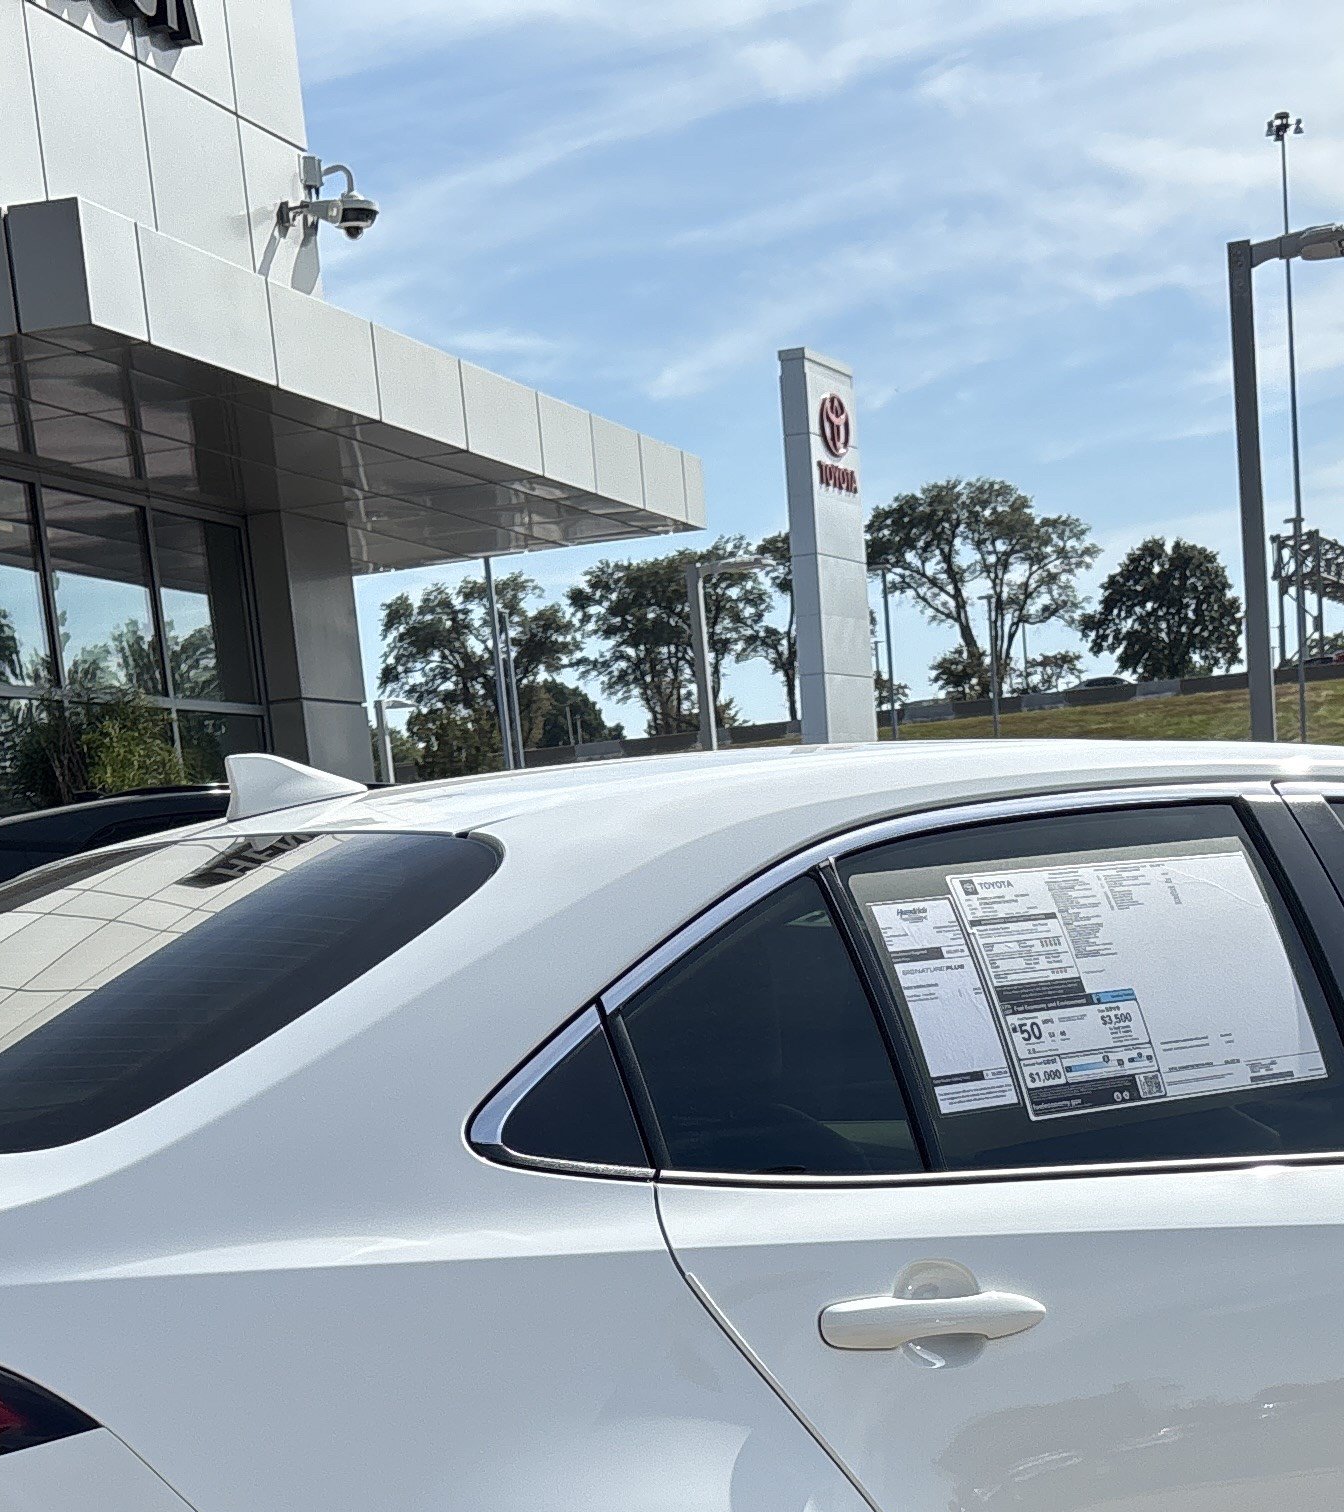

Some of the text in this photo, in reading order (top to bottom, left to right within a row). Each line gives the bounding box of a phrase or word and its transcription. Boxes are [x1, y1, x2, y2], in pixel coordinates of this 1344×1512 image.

[817, 460, 858, 494] TOYOTA
[977, 879, 1014, 891] TOYOTA
[1101, 1012, 1133, 1026] $3,500
[1017, 1021, 1043, 1042] 50
[1028, 1068, 1062, 1084] $1,000
